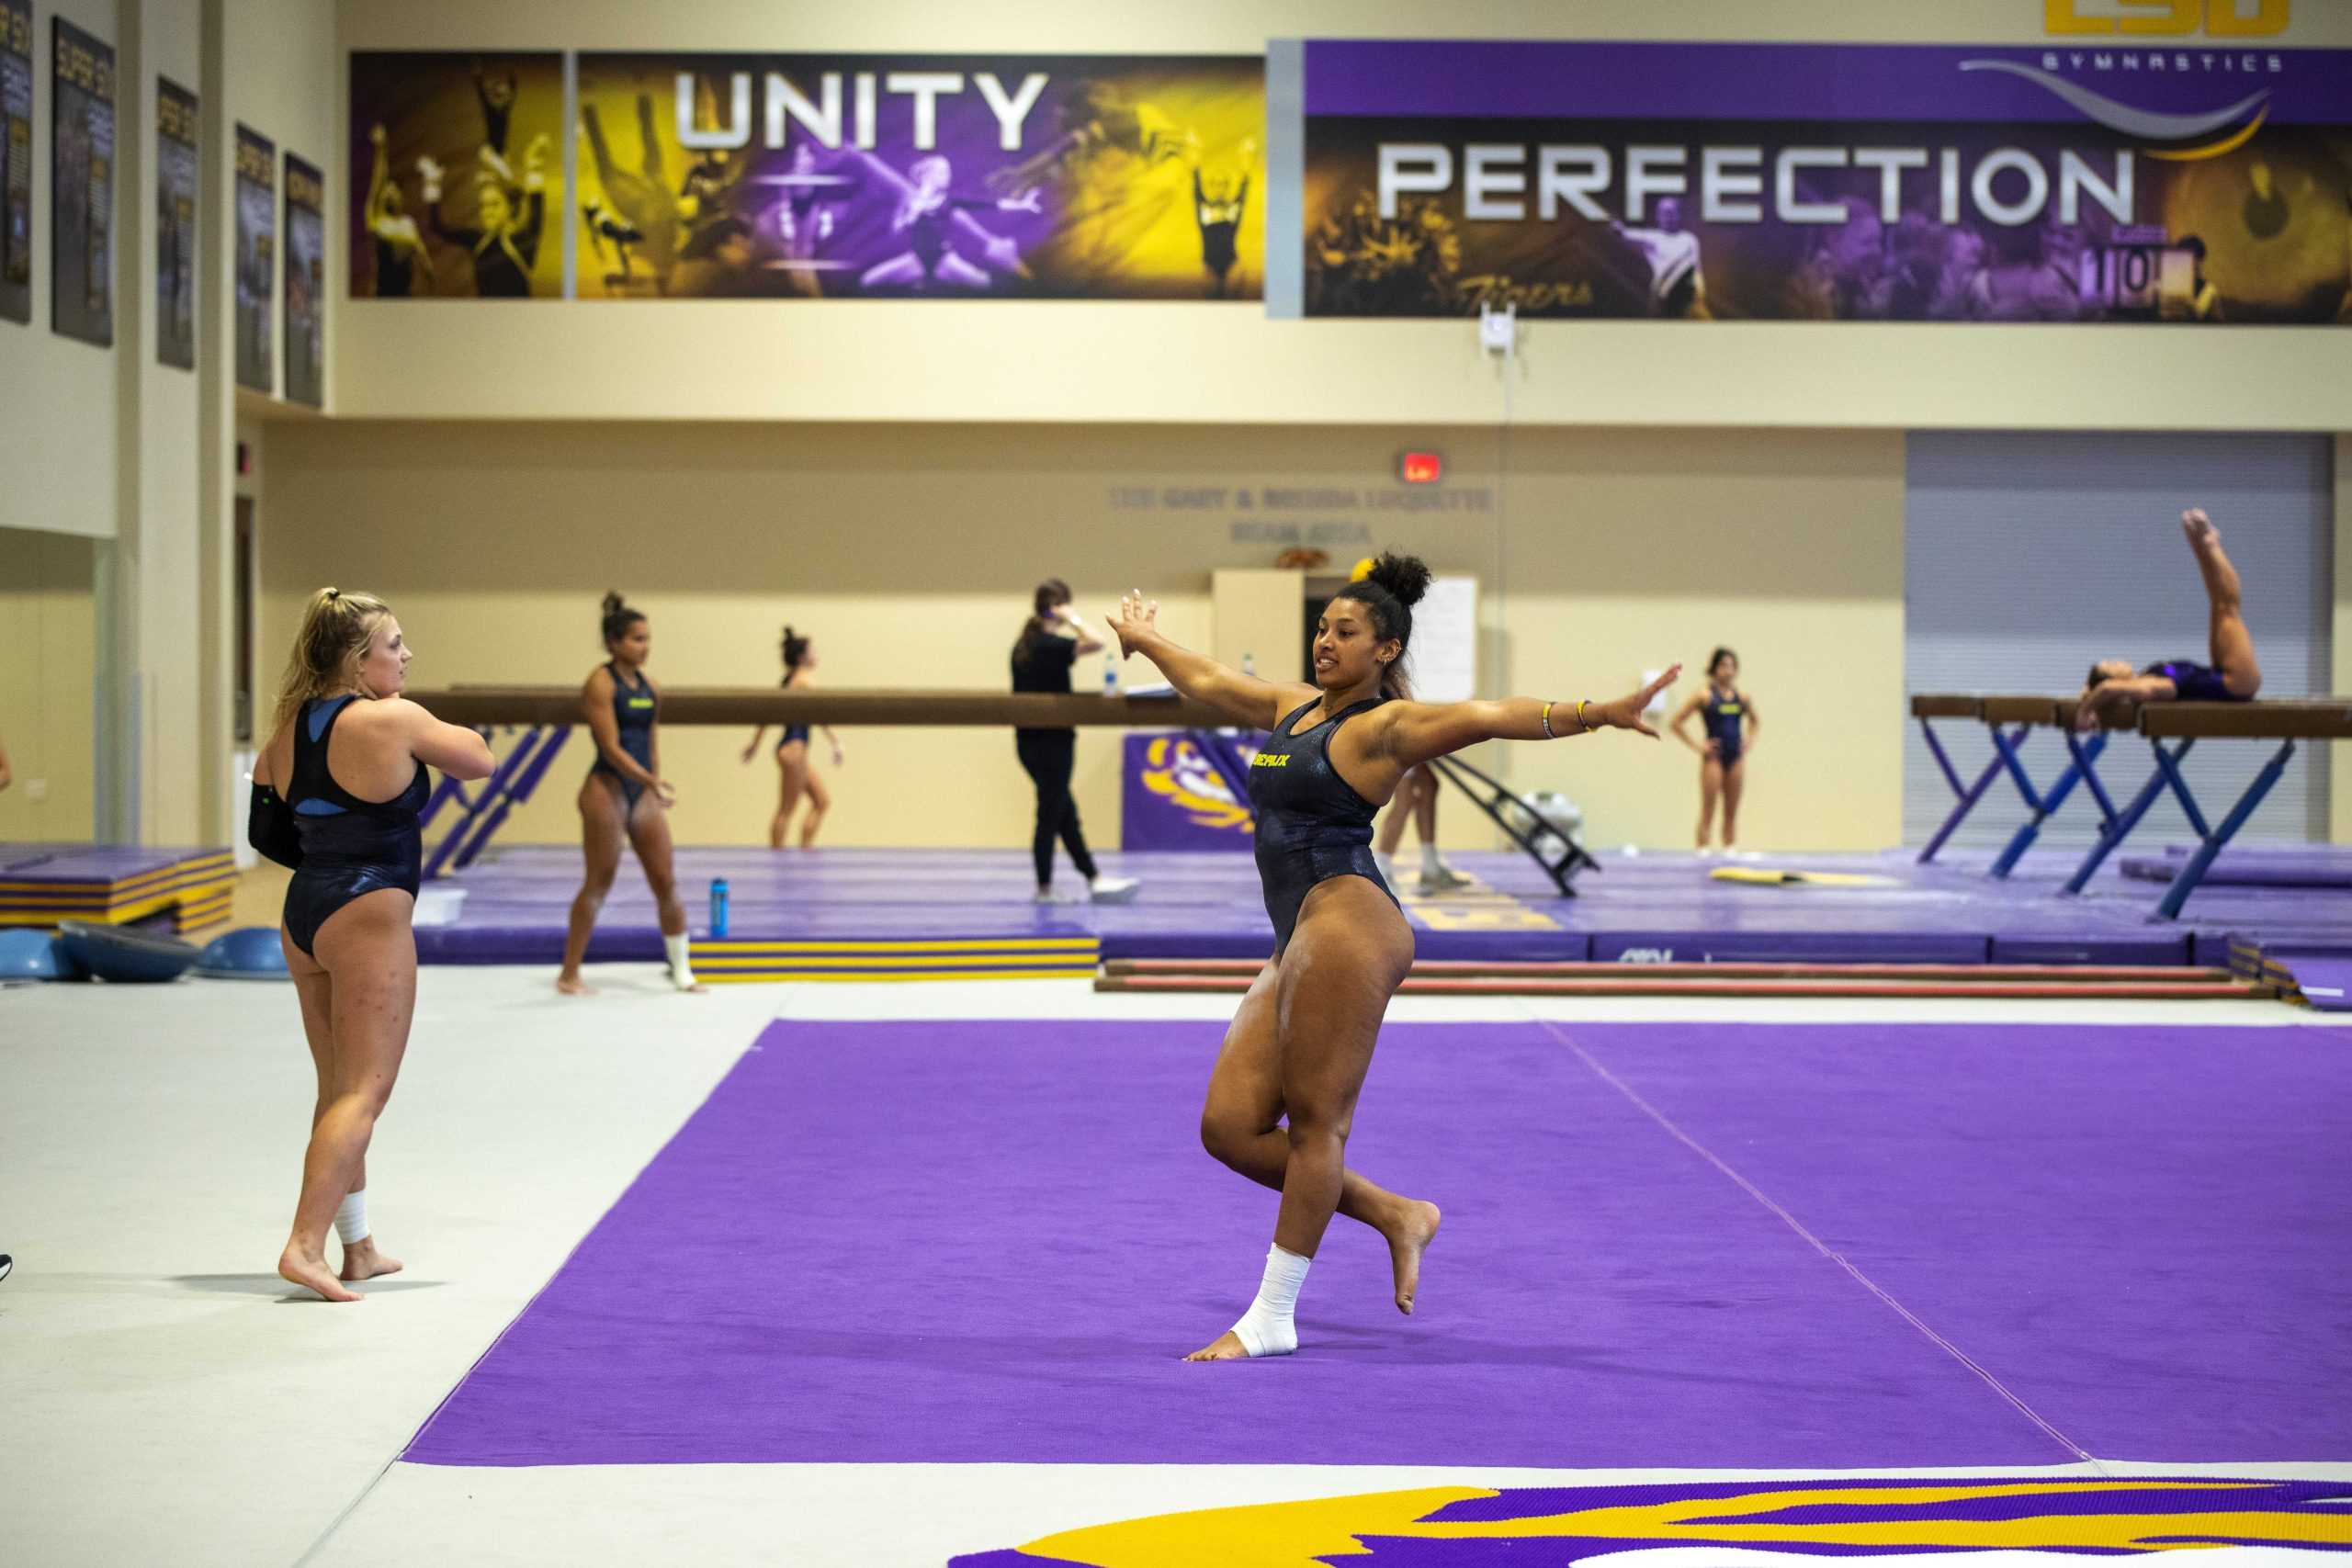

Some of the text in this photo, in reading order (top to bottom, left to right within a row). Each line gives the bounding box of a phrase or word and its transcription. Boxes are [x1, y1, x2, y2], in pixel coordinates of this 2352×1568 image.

[2042, 52, 2283, 73] GYMNASTICS
[674, 72, 1049, 151] UNITY
[1377, 142, 2135, 226] PERFECTION
